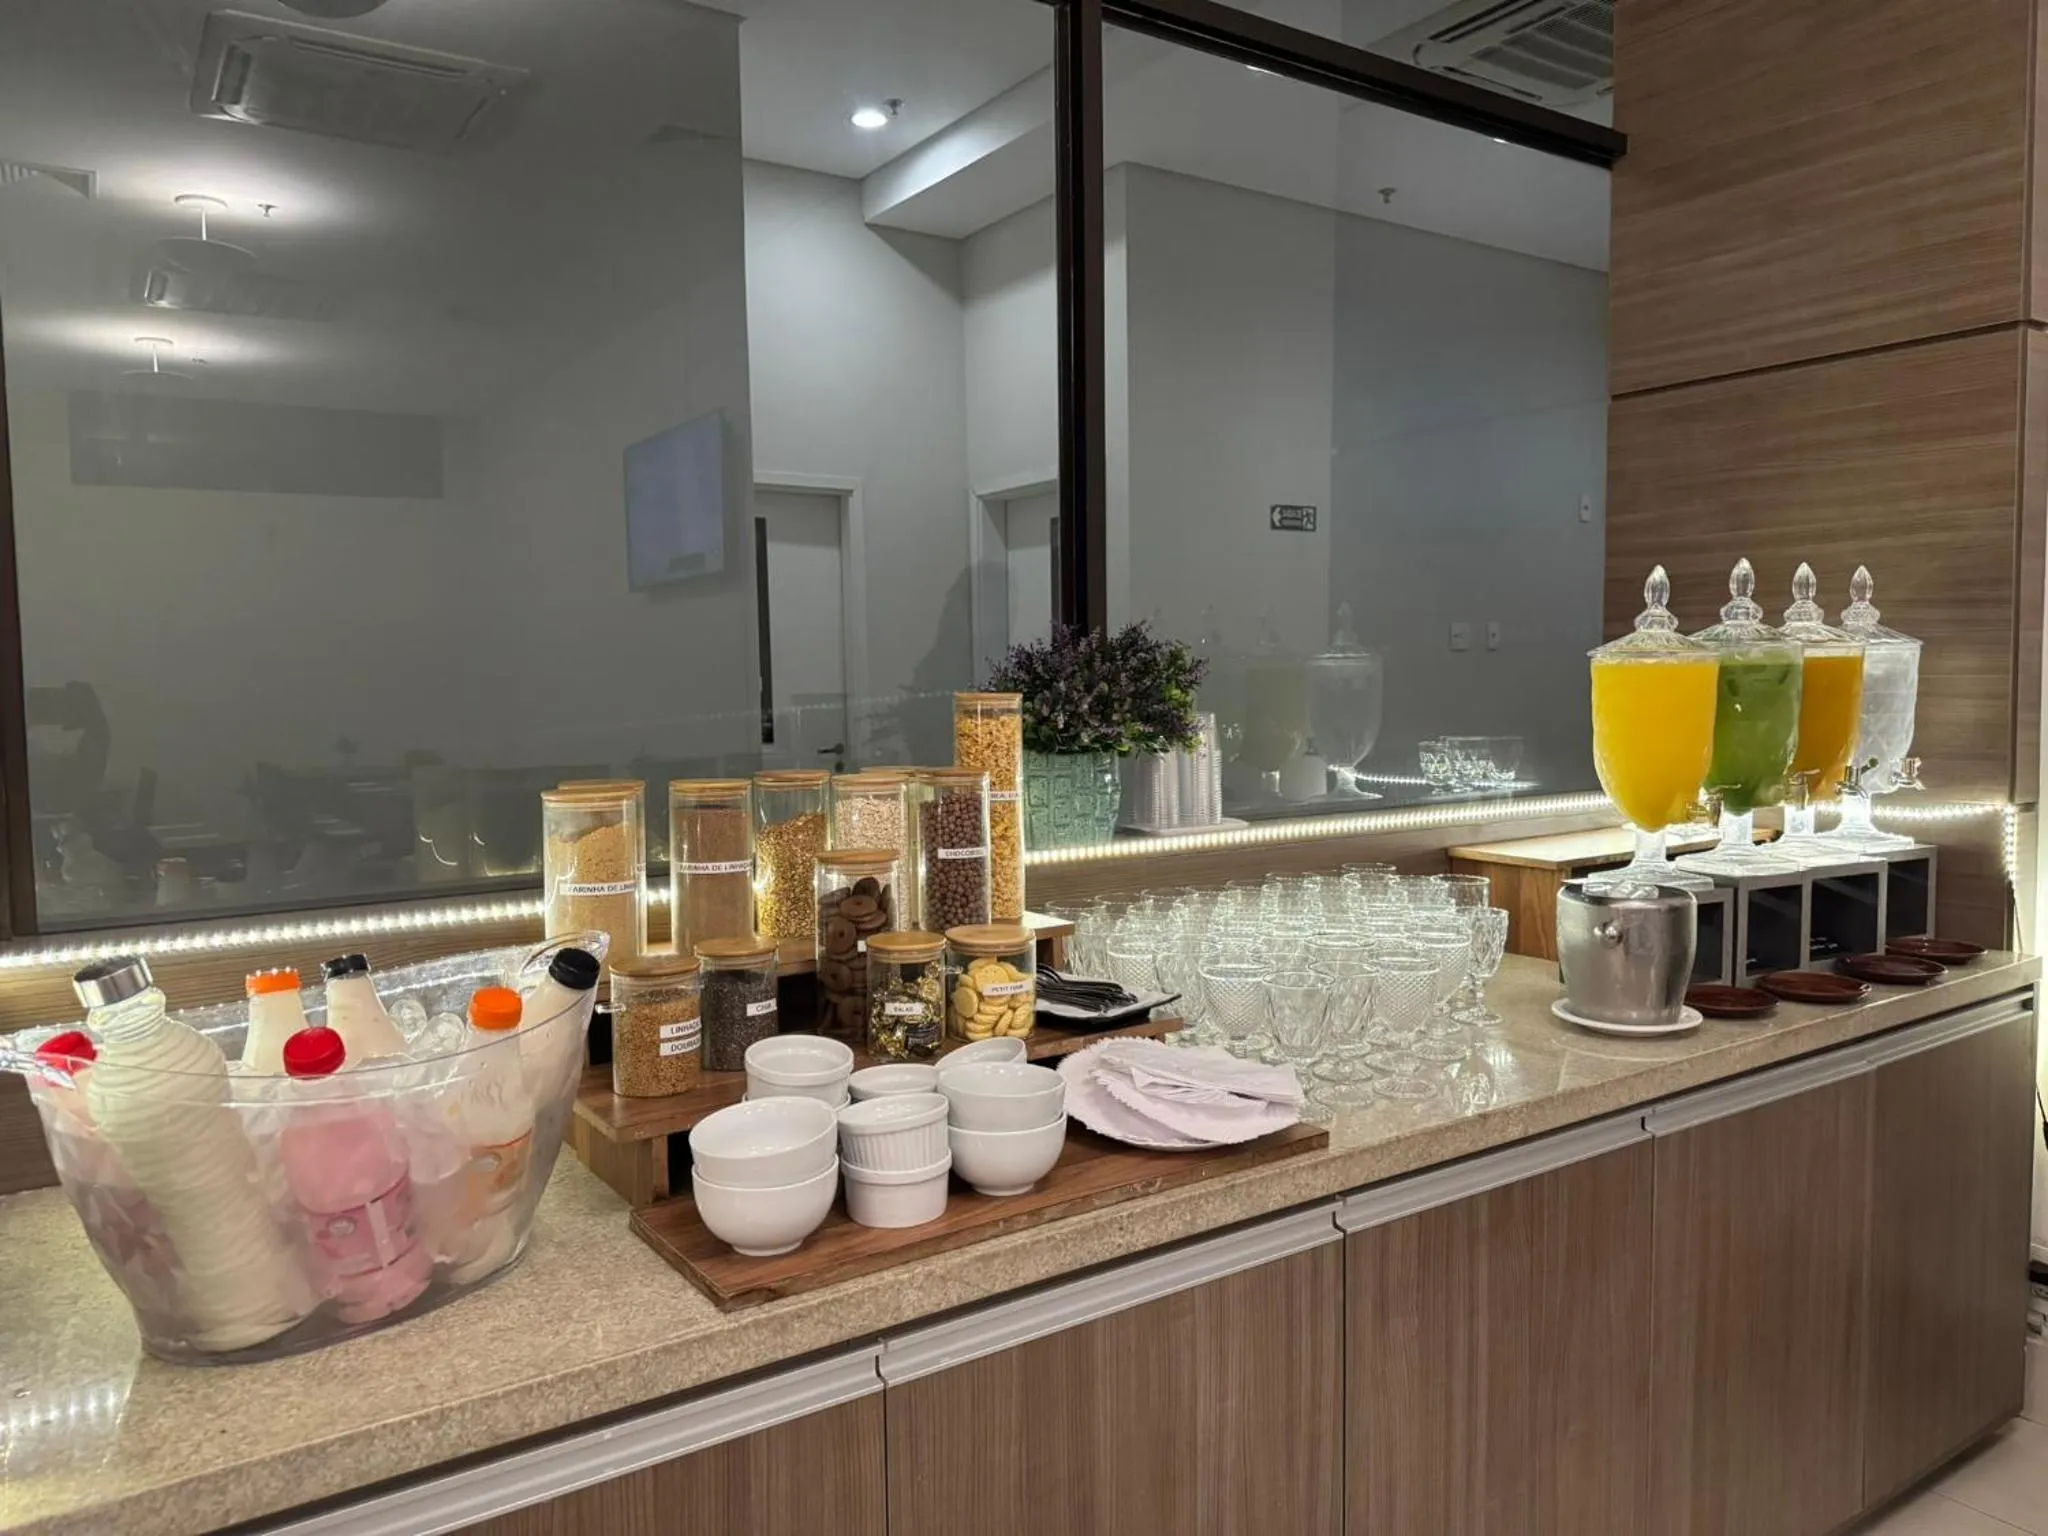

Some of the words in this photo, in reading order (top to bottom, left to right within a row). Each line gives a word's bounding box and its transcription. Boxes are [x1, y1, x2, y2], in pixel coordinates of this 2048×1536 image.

[711, 863, 722, 872] DE
[567, 885, 606, 894] FARINHA
[607, 884, 617, 893] DE
